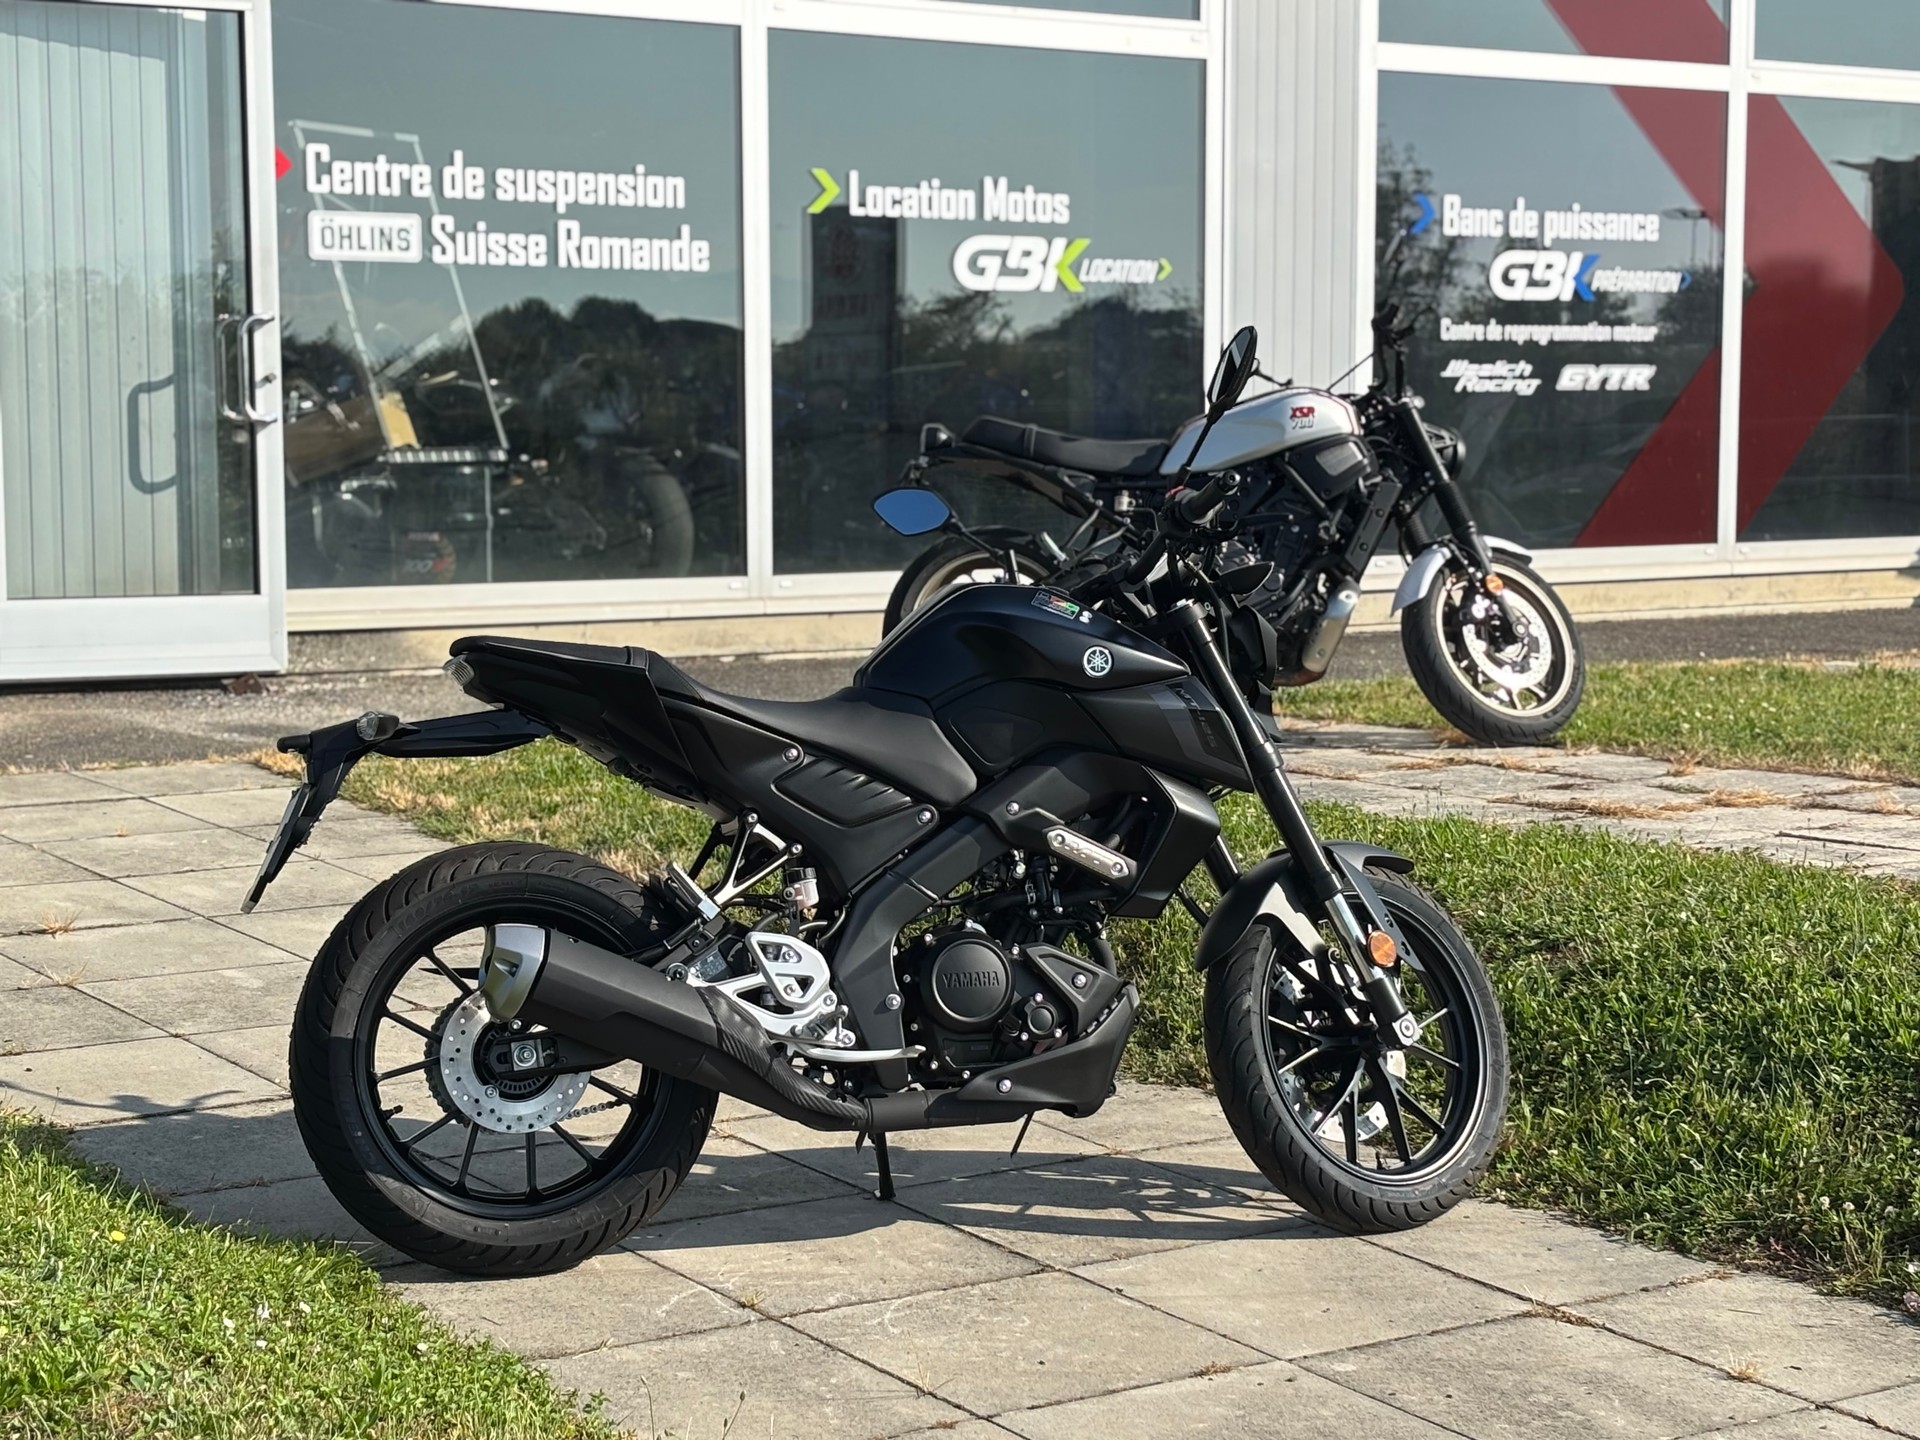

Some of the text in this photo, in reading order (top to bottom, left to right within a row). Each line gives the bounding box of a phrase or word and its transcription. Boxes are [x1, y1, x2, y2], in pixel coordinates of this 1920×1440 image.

[306, 143, 685, 213] Centre de suspension
[850, 170, 1069, 224] Location Motos
[320, 218, 412, 252] ÖHLINS
[432, 214, 710, 272] Suisse Romande
[1443, 194, 1659, 247] Banc de puissance
[953, 235, 1158, 293] GBK LOCATION
[1489, 250, 1598, 301] GBK
[1555, 364, 1657, 391] GYTR
[942, 971, 1000, 989] YAMAHA
